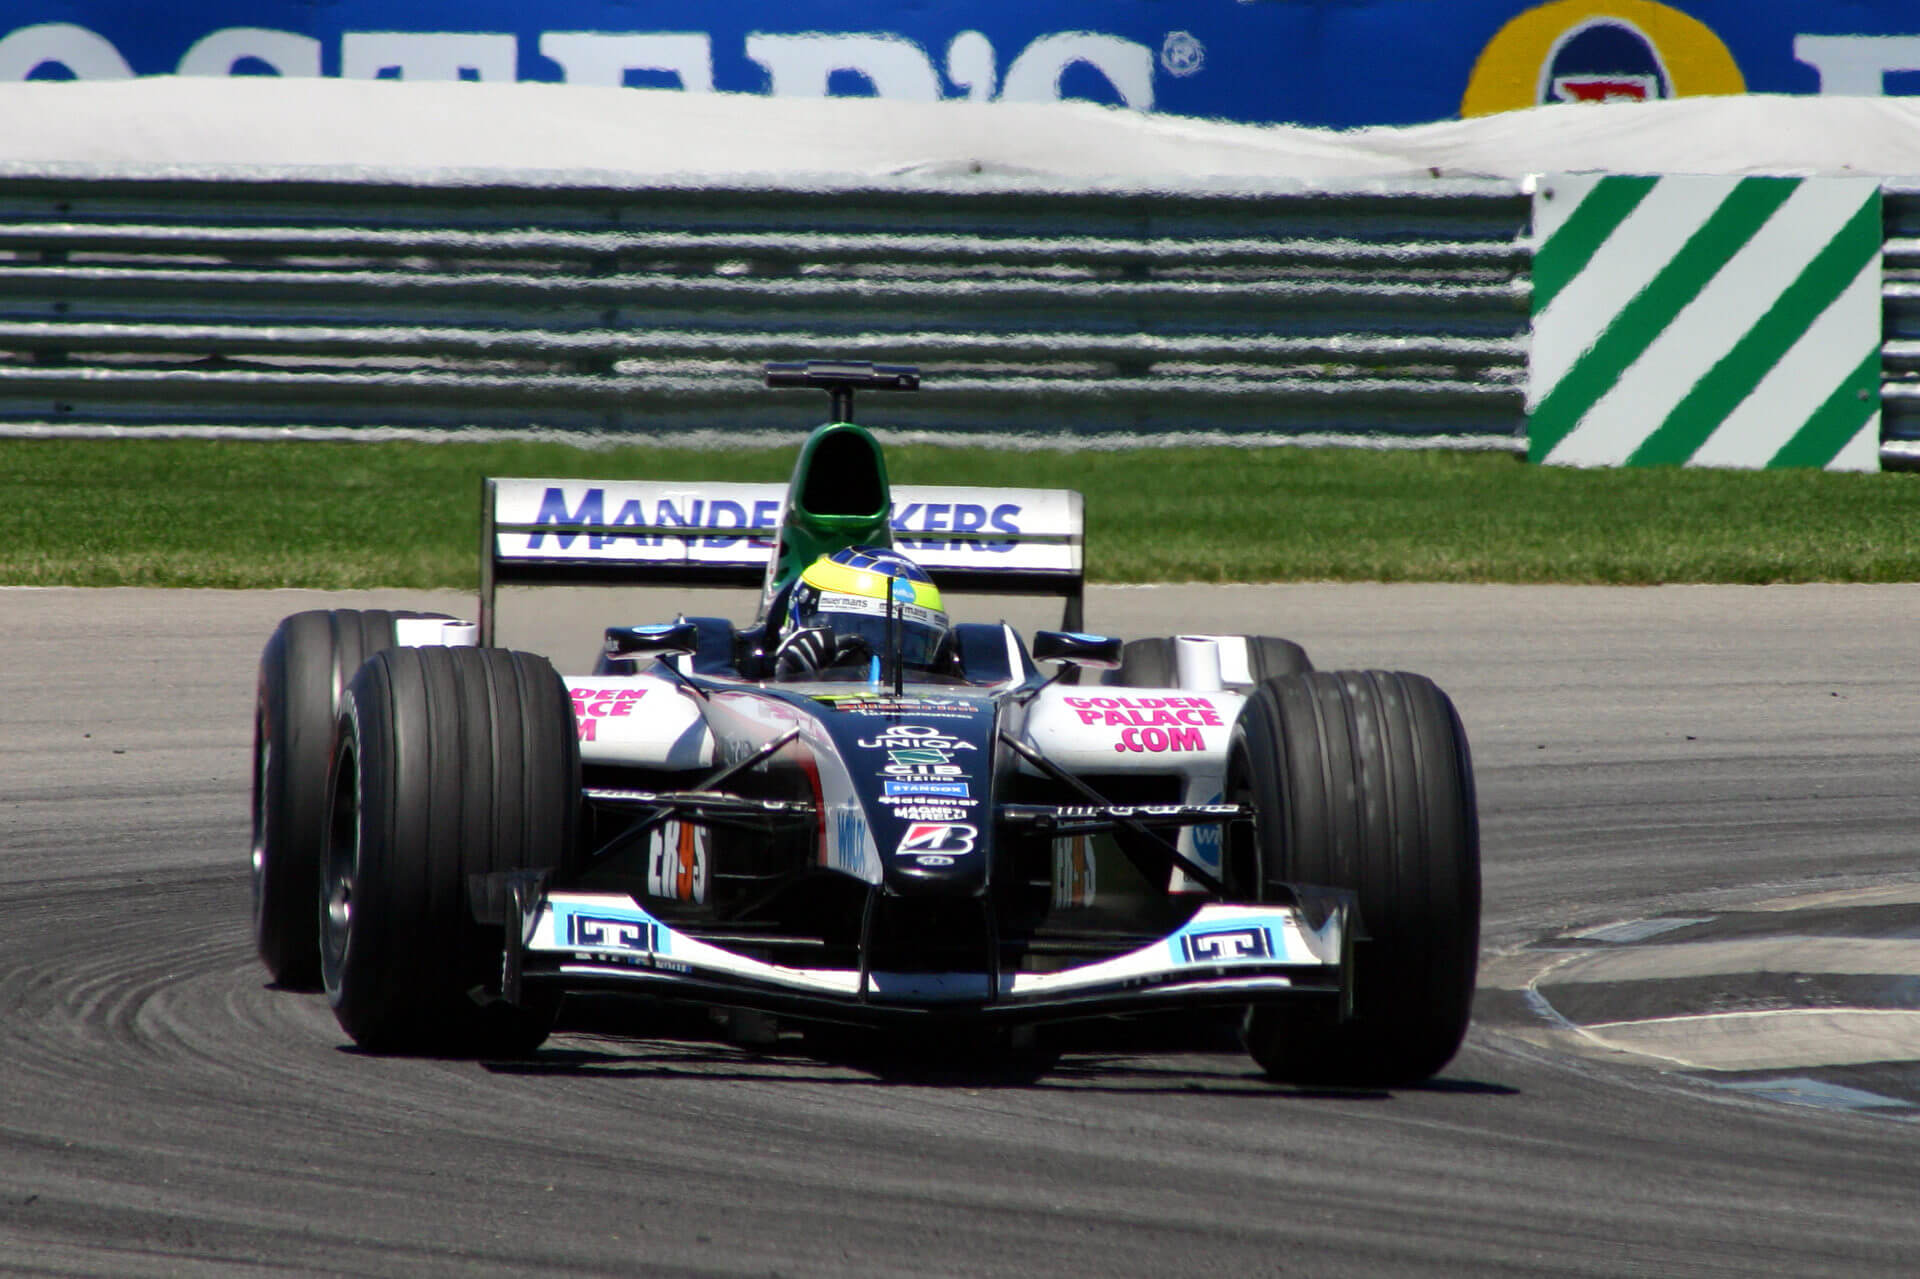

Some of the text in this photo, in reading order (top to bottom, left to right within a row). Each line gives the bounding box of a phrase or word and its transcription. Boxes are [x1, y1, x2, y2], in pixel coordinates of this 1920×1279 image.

[526, 487, 1023, 554] MANDEKERS
[568, 688, 648, 700] DEN
[1063, 697, 1215, 709] GOLDEN
[1075, 709, 1224, 726] PALACE
[857, 738, 978, 750] UNIQA
[1114, 727, 1206, 753] .COM
[884, 765, 963, 775] CIB
[893, 785, 962, 793] STANDOX
